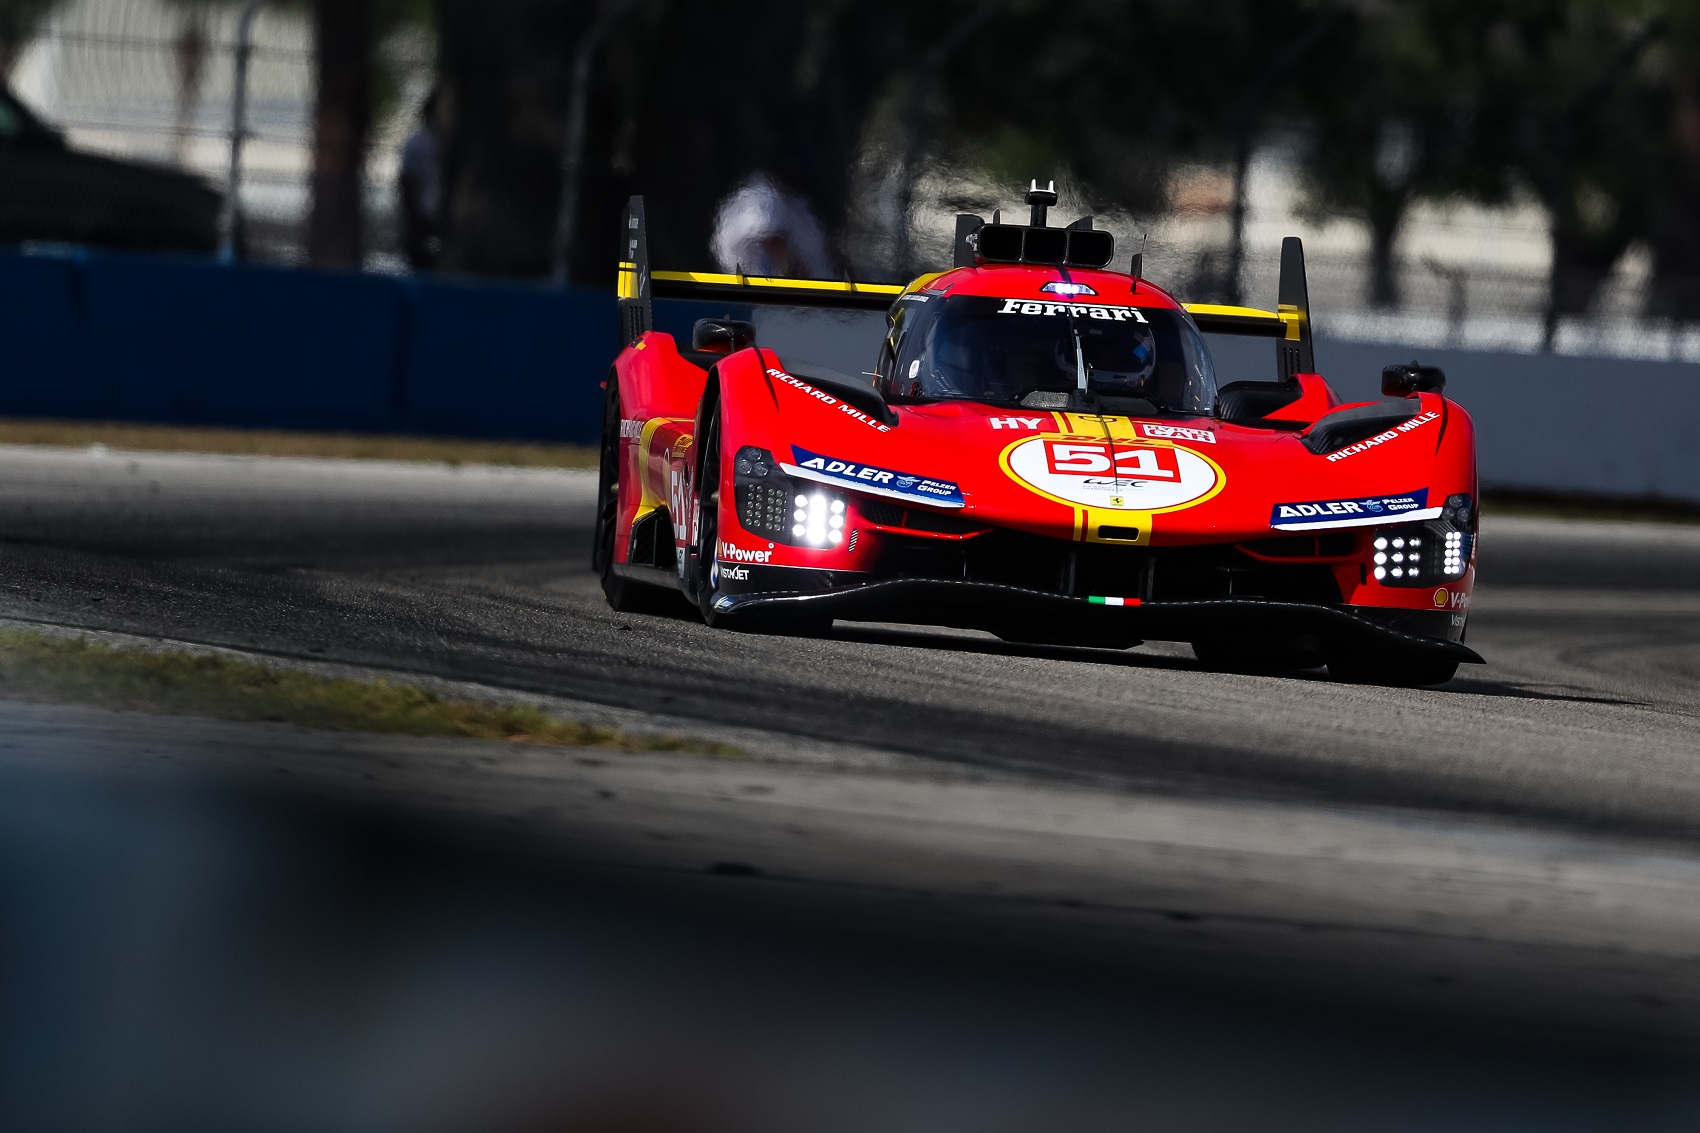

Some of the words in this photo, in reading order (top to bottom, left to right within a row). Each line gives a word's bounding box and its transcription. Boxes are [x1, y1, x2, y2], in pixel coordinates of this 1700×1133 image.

[997, 298, 1149, 324] Ferrari
[766, 368, 837, 405] RICHARD
[837, 404, 891, 433] MILLE
[990, 417, 1043, 430] HY
[1149, 429, 1212, 442] CAR
[1326, 430, 1399, 462] RICHARD
[1397, 411, 1440, 433] MILLE
[1052, 443, 1174, 478] 51
[800, 457, 895, 484] ADLER
[917, 485, 952, 496] GROUP
[921, 479, 957, 490] PELZER
[1083, 478, 1149, 488] WEC
[1381, 497, 1415, 505] PELZER
[1387, 503, 1420, 511] GROUP
[1279, 501, 1364, 518] ADLER
[722, 542, 773, 562] V-Power
